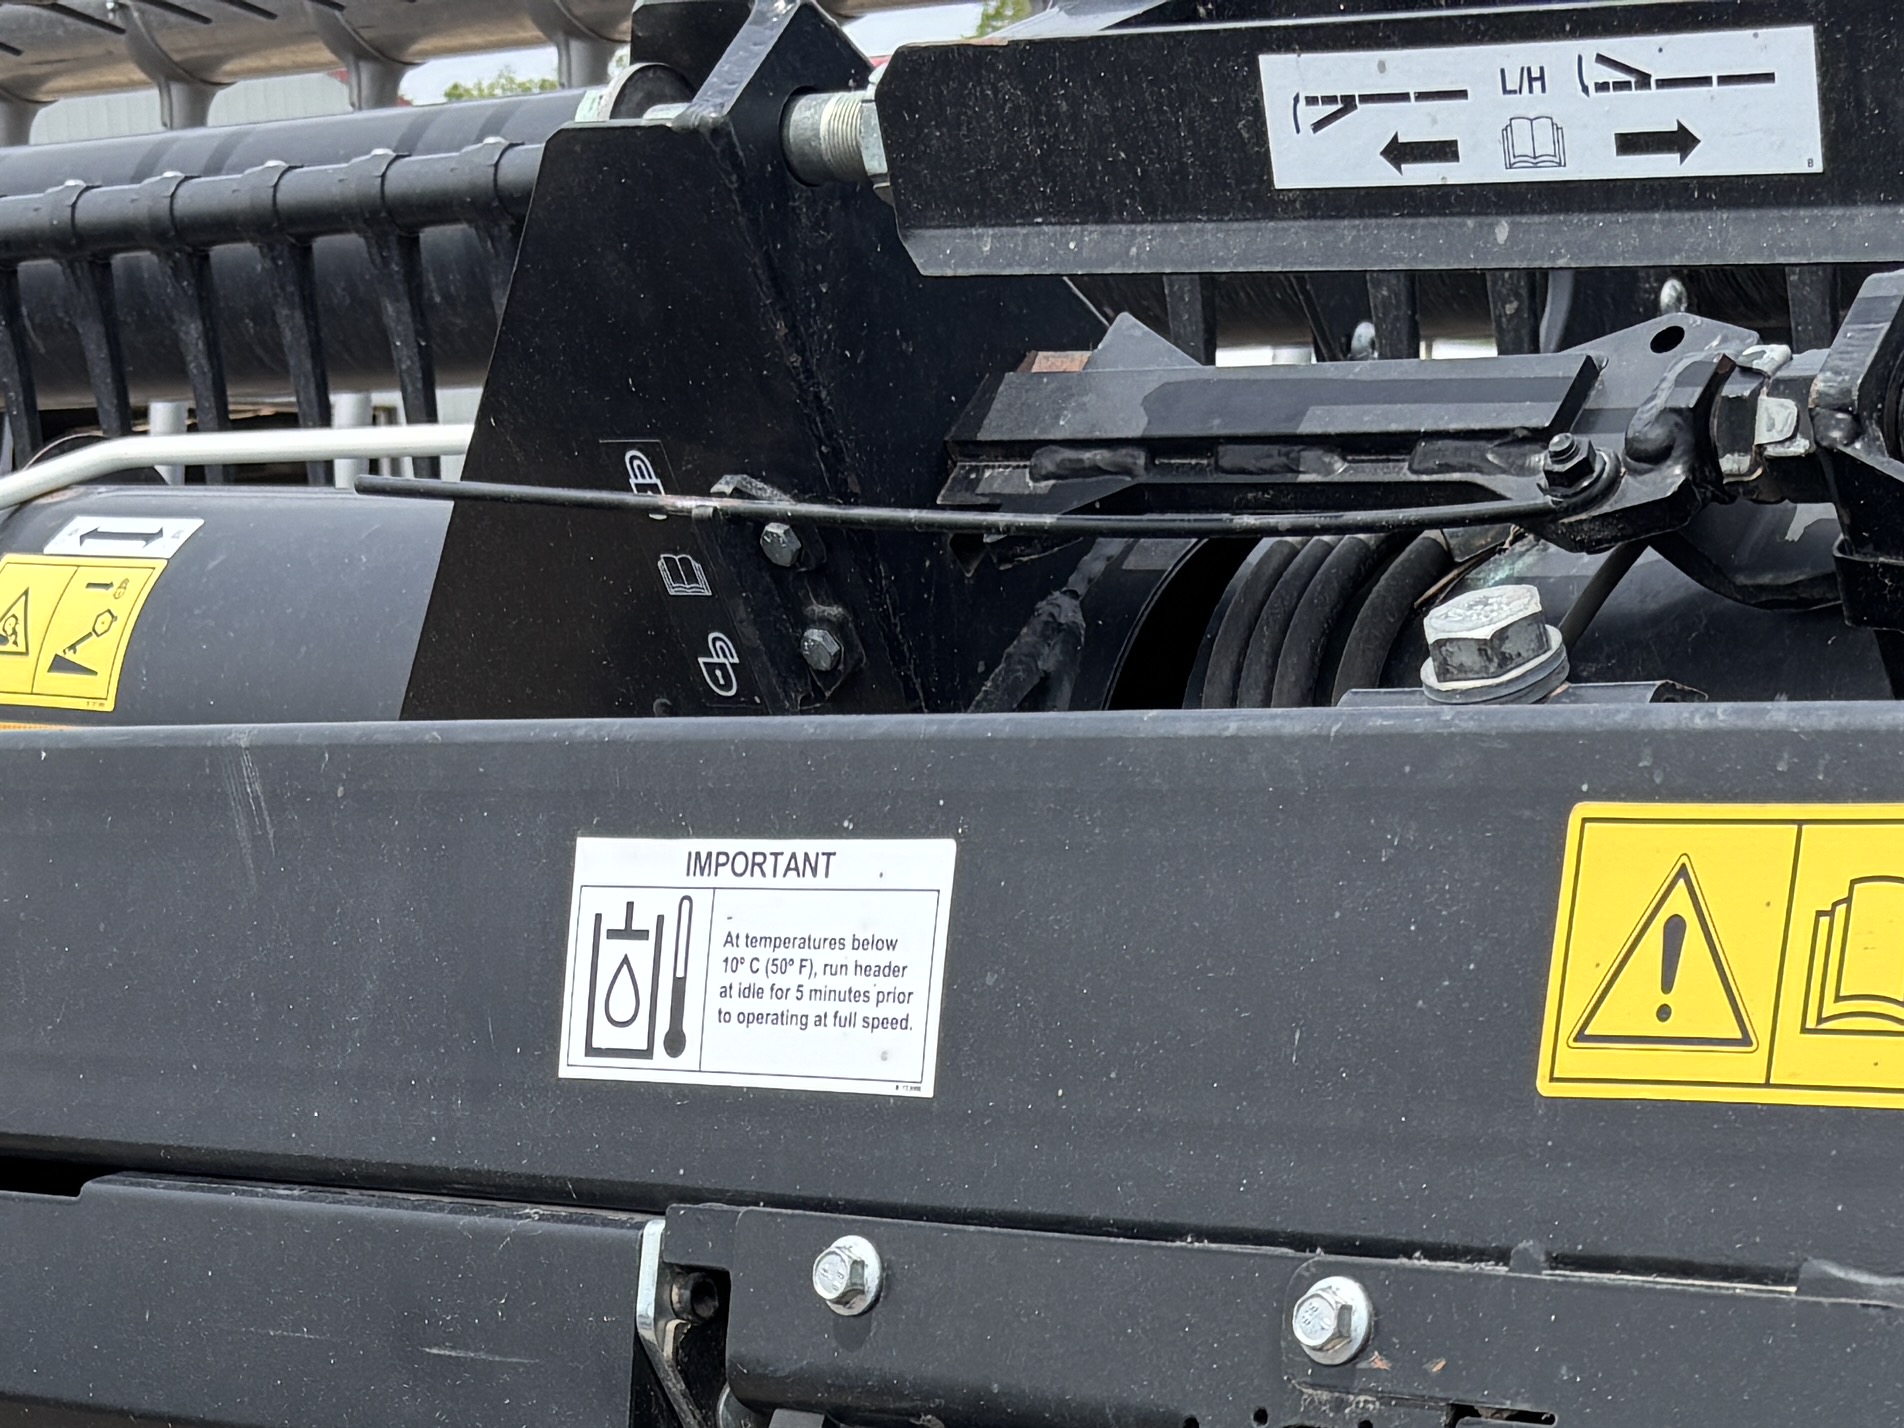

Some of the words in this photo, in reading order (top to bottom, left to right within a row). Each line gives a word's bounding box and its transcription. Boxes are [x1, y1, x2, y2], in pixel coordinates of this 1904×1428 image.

[1500, 65, 1546, 95] L/H
[685, 851, 837, 879] IMPORTANT
[722, 932, 740, 949] At
[744, 935, 846, 954] temperatures
[851, 935, 898, 953] below
[722, 957, 745, 974] 10°
[749, 958, 761, 975] C
[765, 957, 795, 980] (50°
[798, 959, 818, 981] F),
[823, 962, 849, 978] run
[854, 961, 909, 979] header
[719, 985, 734, 1000] at
[738, 984, 765, 1001] idle
[770, 985, 792, 1002] for
[795, 985, 804, 1002] 5
[809, 985, 871, 1004] minutes
[876, 987, 915, 1009] prior
[718, 1009, 732, 1025] to
[737, 1010, 809, 1031] operating
[813, 1011, 828, 1028] at
[833, 1010, 858, 1029] full
[862, 1014, 915, 1034] speed.
